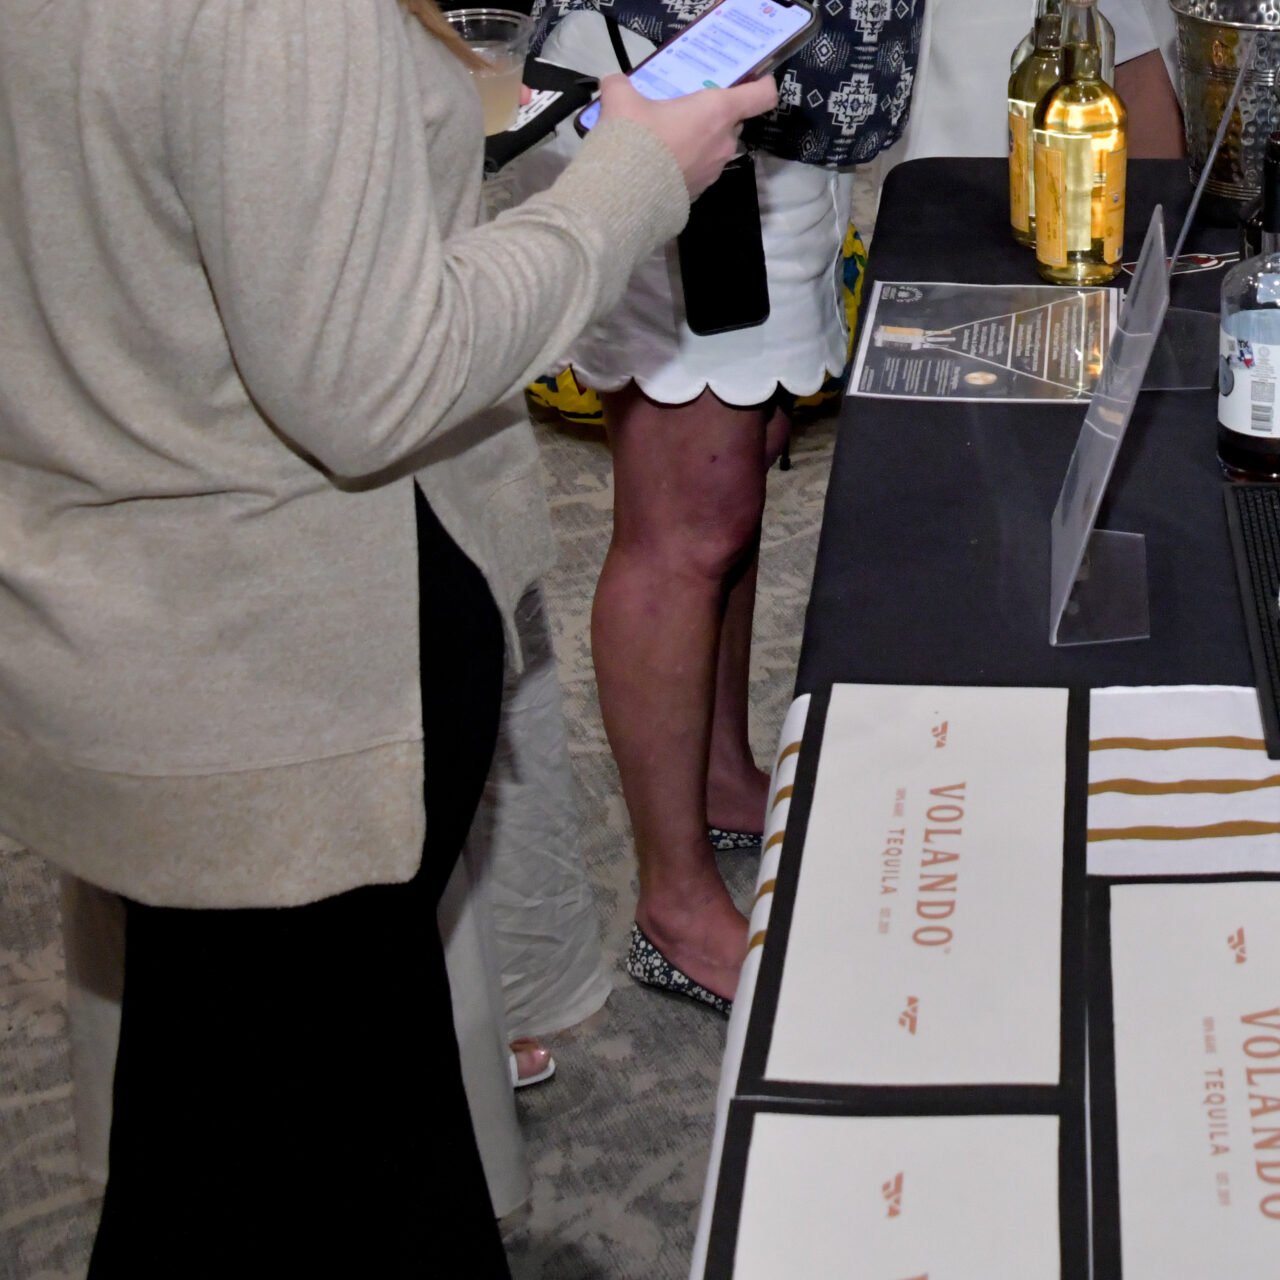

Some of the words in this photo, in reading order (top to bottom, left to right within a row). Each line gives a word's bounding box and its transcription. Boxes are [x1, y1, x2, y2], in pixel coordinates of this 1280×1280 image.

[880, 827, 905, 895] TEQUILA
[912, 782, 966, 947] VOLANDO
[1203, 1067, 1231, 1157] TEQUILA
